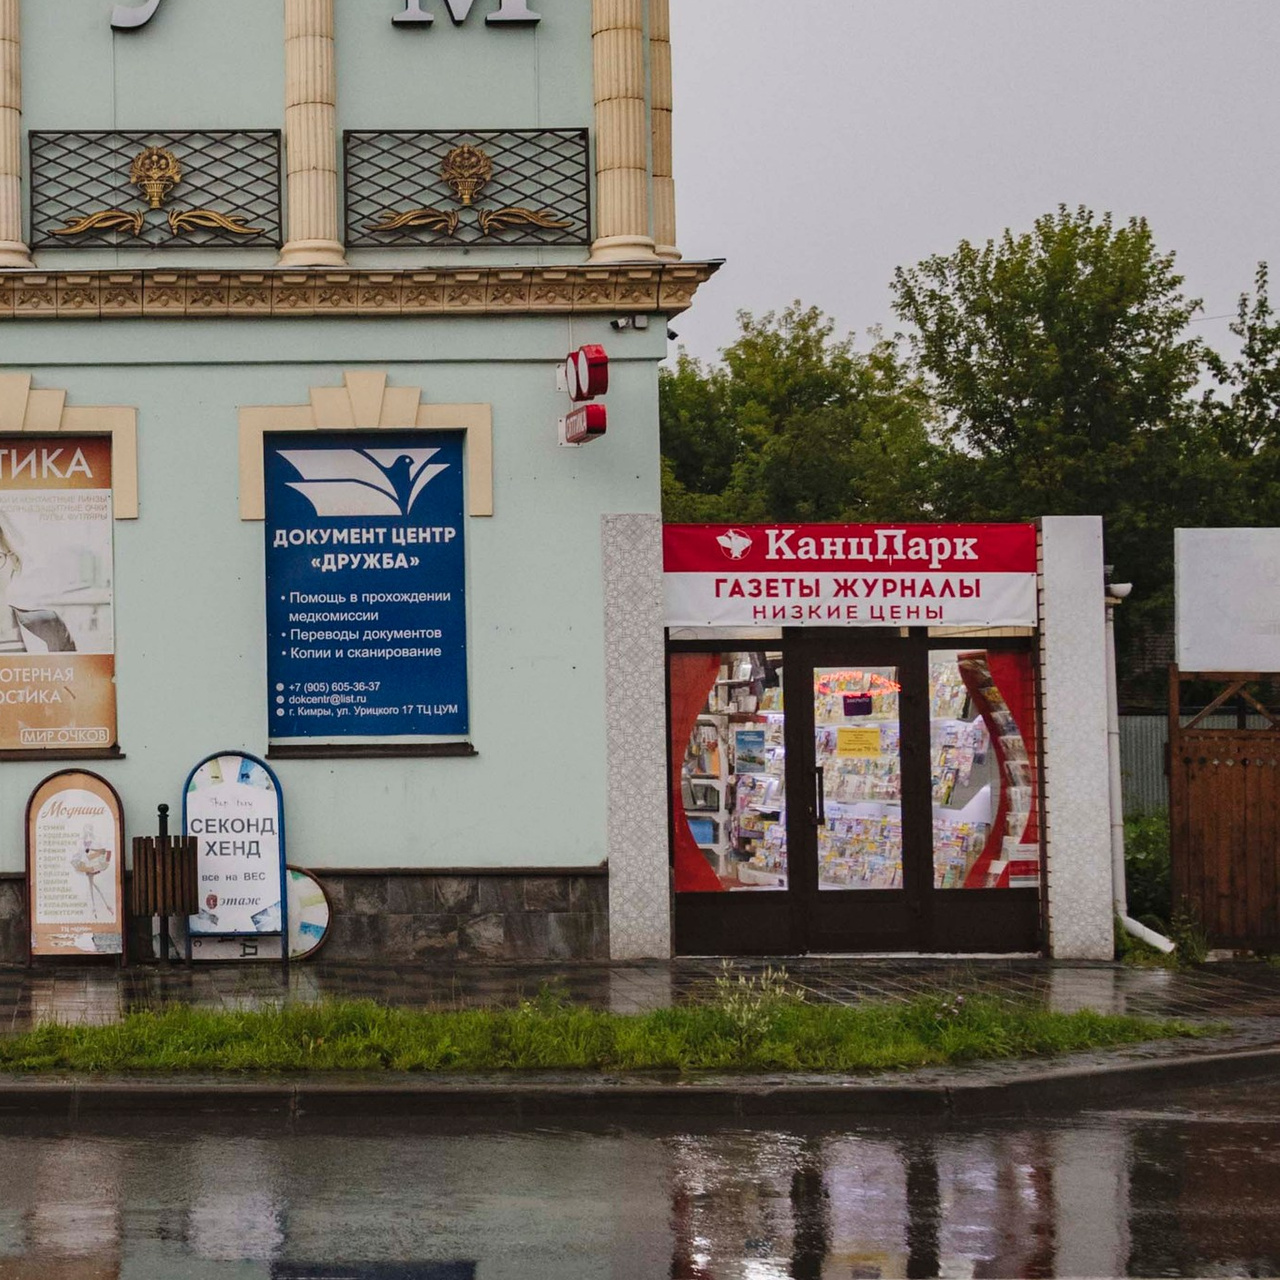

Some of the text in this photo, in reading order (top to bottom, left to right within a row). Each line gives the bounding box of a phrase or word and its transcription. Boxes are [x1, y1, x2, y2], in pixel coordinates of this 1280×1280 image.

[273, 527, 456, 548] ДОКУМЕНТ ЦЕНТР
[765, 529, 978, 569] КанцПарк
[311, 552, 420, 572] «ДРУЖБА»
[715, 578, 981, 598] ГАЗЕТЫ ЖУРНАЛЫ
[289, 591, 451, 604] Помощь в прохождении
[289, 611, 378, 623] медкомиссии
[753, 605, 943, 621] НИЗКИЕ ЦЕНЫ
[290, 629, 442, 642] Переводы документов
[290, 647, 442, 659] Копии и сканирование
[289, 681, 381, 694] +7 (905) 605-36-37
[289, 694, 367, 705] dokcentr@list.ru
[298, 706, 334, 717] Кимры,
[336, 707, 351, 717] ул.
[353, 705, 399, 717] Урицкого
[402, 705, 413, 714] 17
[416, 705, 431, 716] ТЦ
[434, 704, 458, 715] ЦУМ
[24, 730, 107, 743] МИР ОЧКОВ
[42, 801, 105, 818] Модница
[190, 818, 275, 835] СЕКОНД
[205, 840, 261, 858] ХЕНД
[201, 872, 266, 882] все на ВЕС
[220, 897, 261, 907] этаж
